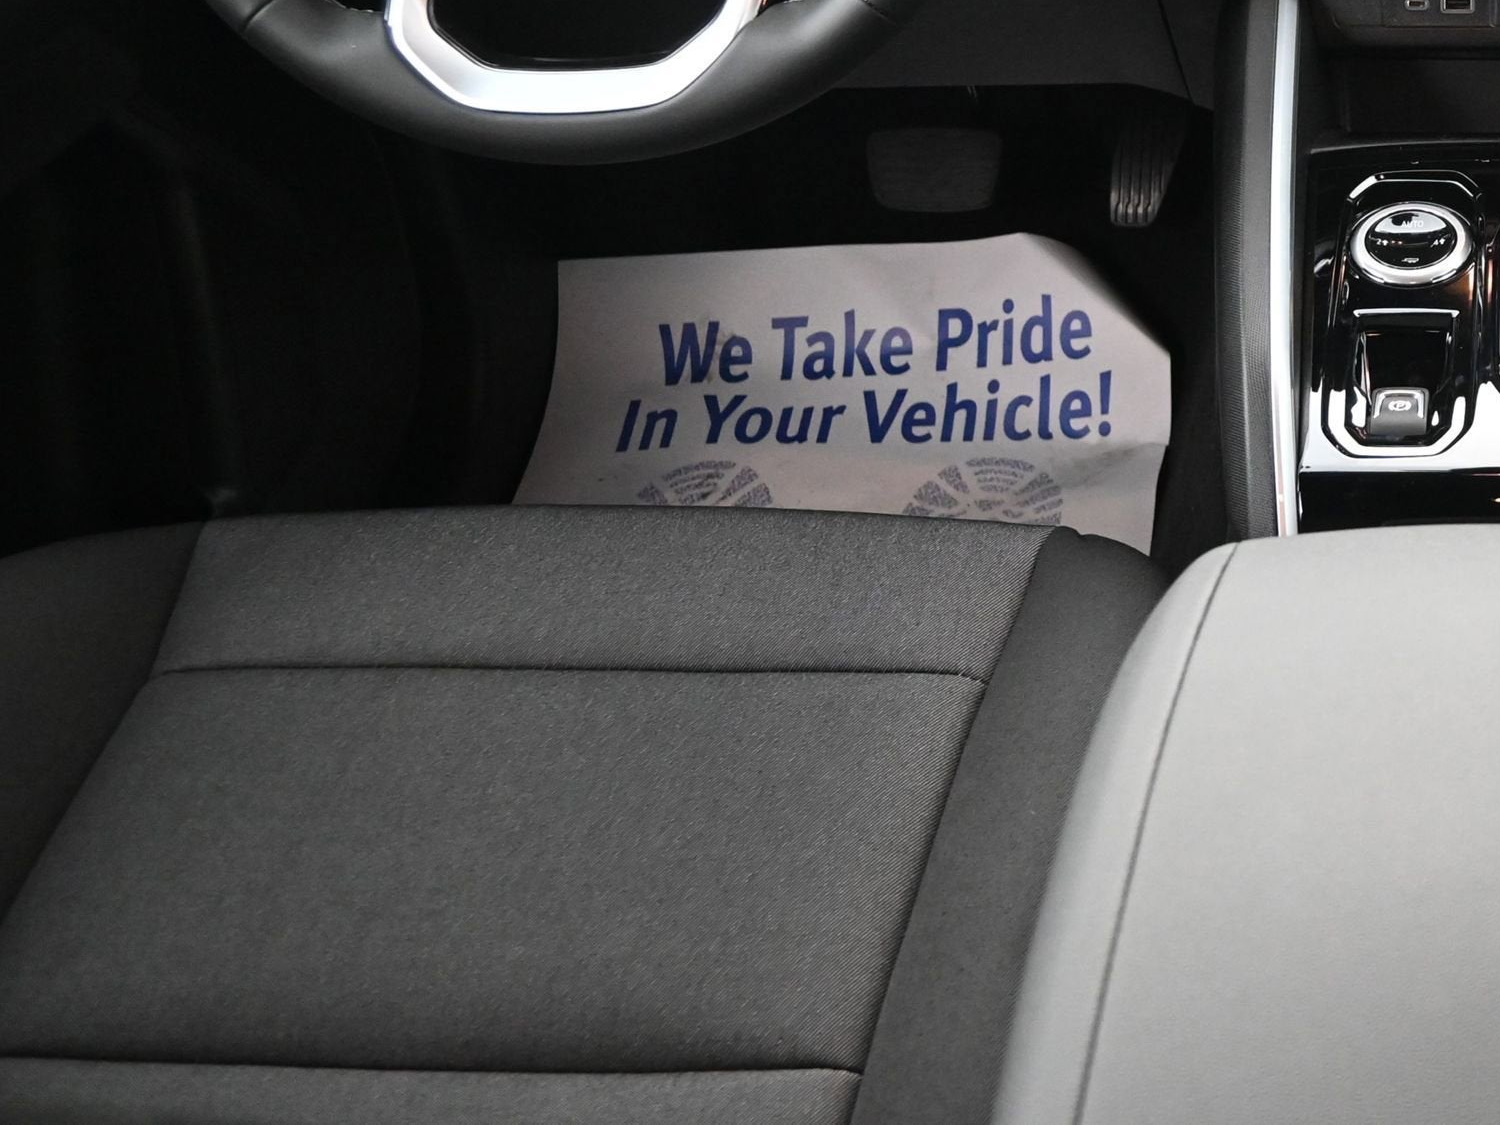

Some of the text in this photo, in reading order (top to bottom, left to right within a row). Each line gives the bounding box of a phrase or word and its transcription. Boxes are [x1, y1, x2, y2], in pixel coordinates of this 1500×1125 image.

[1401, 220, 1424, 228] AUTO
[658, 294, 1093, 386] We Take Pride
[615, 370, 1113, 453] In Your Vehicle!
